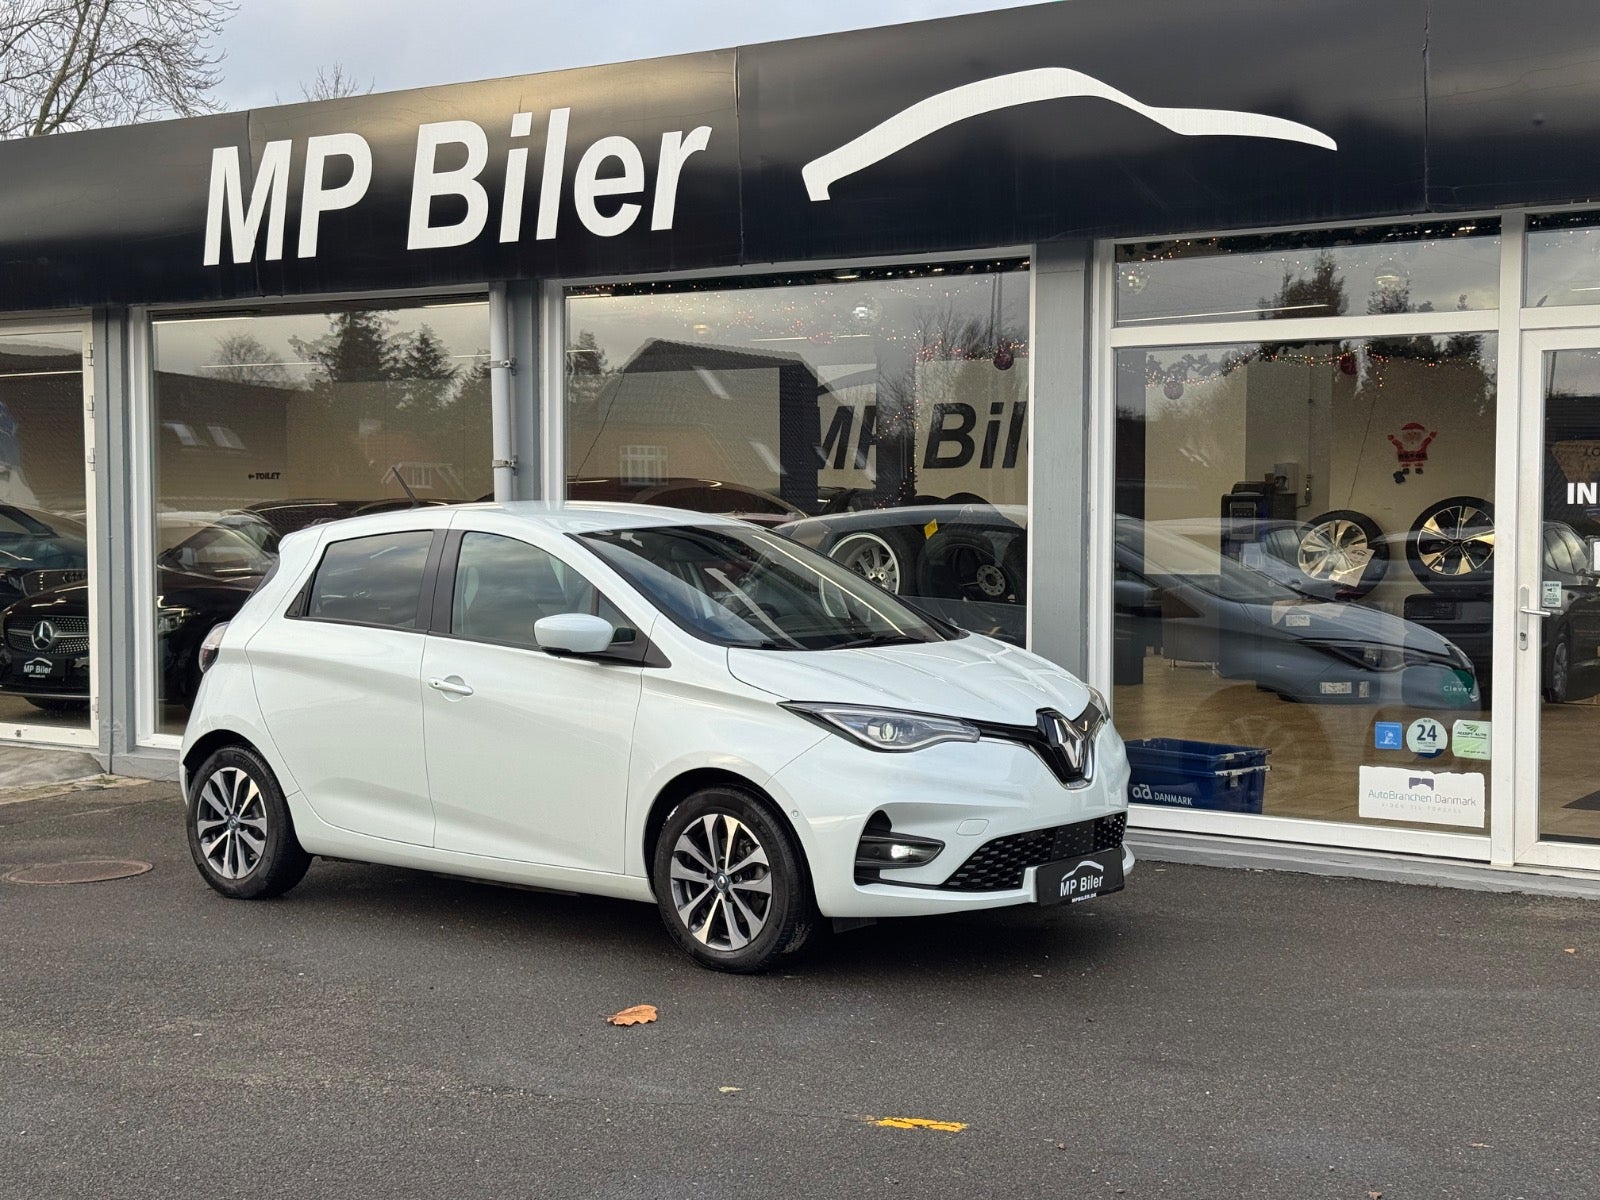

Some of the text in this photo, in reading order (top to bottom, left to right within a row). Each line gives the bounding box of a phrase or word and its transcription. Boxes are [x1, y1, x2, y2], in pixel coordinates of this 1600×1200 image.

[203, 106, 713, 267] MP Biler
[922, 401, 1029, 470] Bil
[255, 472, 280, 480] TOILET
[1566, 482, 1600, 505] IN
[23, 665, 52, 674] MP Biler
[1417, 725, 1437, 741] 24
[1154, 792, 1193, 806] DANMARK
[1368, 789, 1477, 807] AutoBranchen Danmark
[1060, 874, 1104, 897] MP Biler
